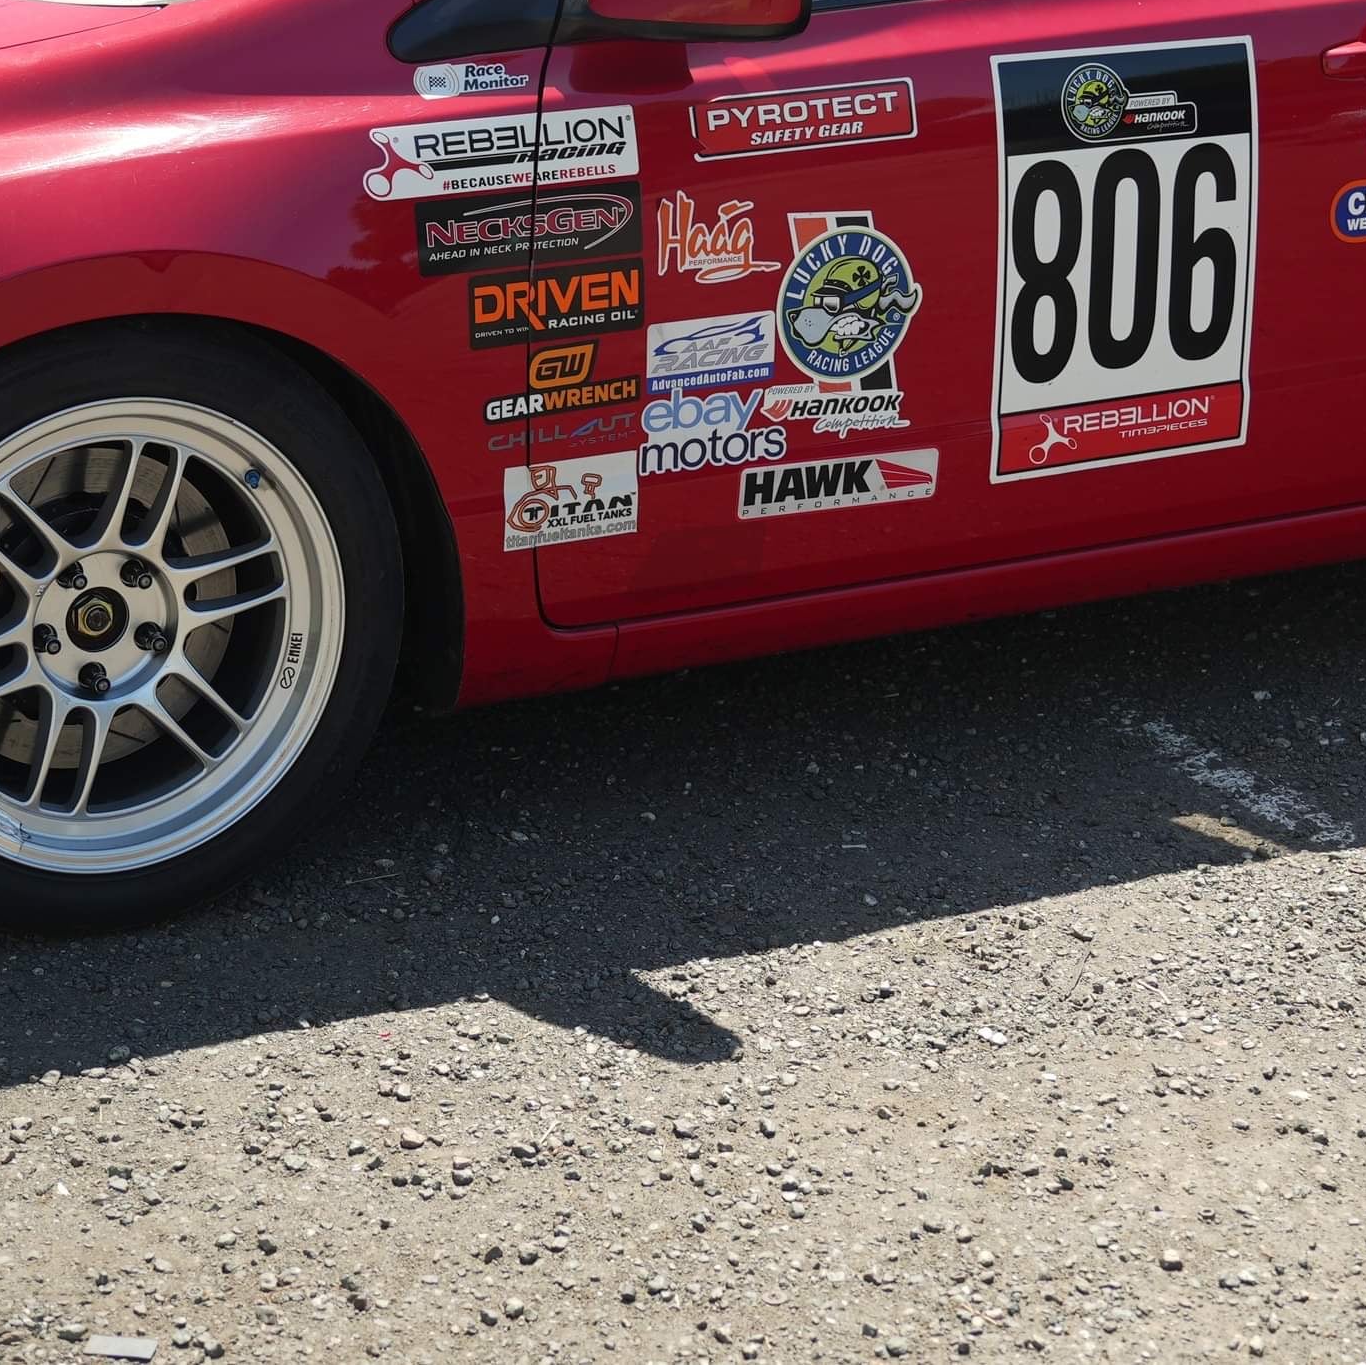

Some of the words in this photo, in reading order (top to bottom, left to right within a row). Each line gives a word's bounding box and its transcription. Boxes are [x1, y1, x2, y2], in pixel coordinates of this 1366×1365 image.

[463, 75, 528, 91] Monitor
[464, 64, 504, 77] Race
[1068, 70, 1092, 102] LUCKY
[1096, 71, 1115, 88] DOG
[707, 91, 898, 131] PYROTECT
[1129, 98, 1160, 108] POWERED
[1162, 97, 1171, 105] BY
[413, 116, 625, 159] REBELLION
[750, 125, 814, 145] SAFETY
[818, 121, 863, 137] GEAR
[443, 164, 616, 191] #BECAUSEWEAREREBELLS
[658, 190, 781, 284] Haag
[429, 249, 466, 262] AHEAD
[470, 247, 481, 258] IN
[484, 243, 512, 256] NECK
[688, 255, 743, 267] PERFORMANCE
[1011, 143, 1236, 384] 806
[786, 234, 848, 301] LUCKY
[858, 235, 899, 275] DOG
[474, 270, 639, 330] DRIVEN
[548, 314, 605, 329] RACING
[610, 309, 636, 321] OIL
[475, 330, 503, 339] DRIVEN
[681, 337, 732, 354] AAF
[651, 343, 769, 374] RACING
[806, 349, 851, 373] RACING
[854, 327, 896, 369] LEAGUE
[651, 367, 770, 391] AdvancedAutoFab.com
[767, 386, 803, 396] POWERED
[804, 385, 815, 393] BY
[486, 380, 636, 421] GEARWRENCH
[644, 389, 762, 433] ebay
[1064, 396, 1209, 434] REBELLION
[816, 414, 908, 436] Competition
[641, 428, 785, 475] motors
[743, 459, 873, 507] HAWK
[524, 494, 633, 521] TITAN
[742, 488, 932, 517] PERFORMANCE
[547, 515, 569, 528] XXL
[570, 512, 596, 525] FUEL
[598, 507, 632, 521] TANKS
[506, 520, 636, 549] titanfueltanks.com
[287, 633, 303, 664] ENKEI
